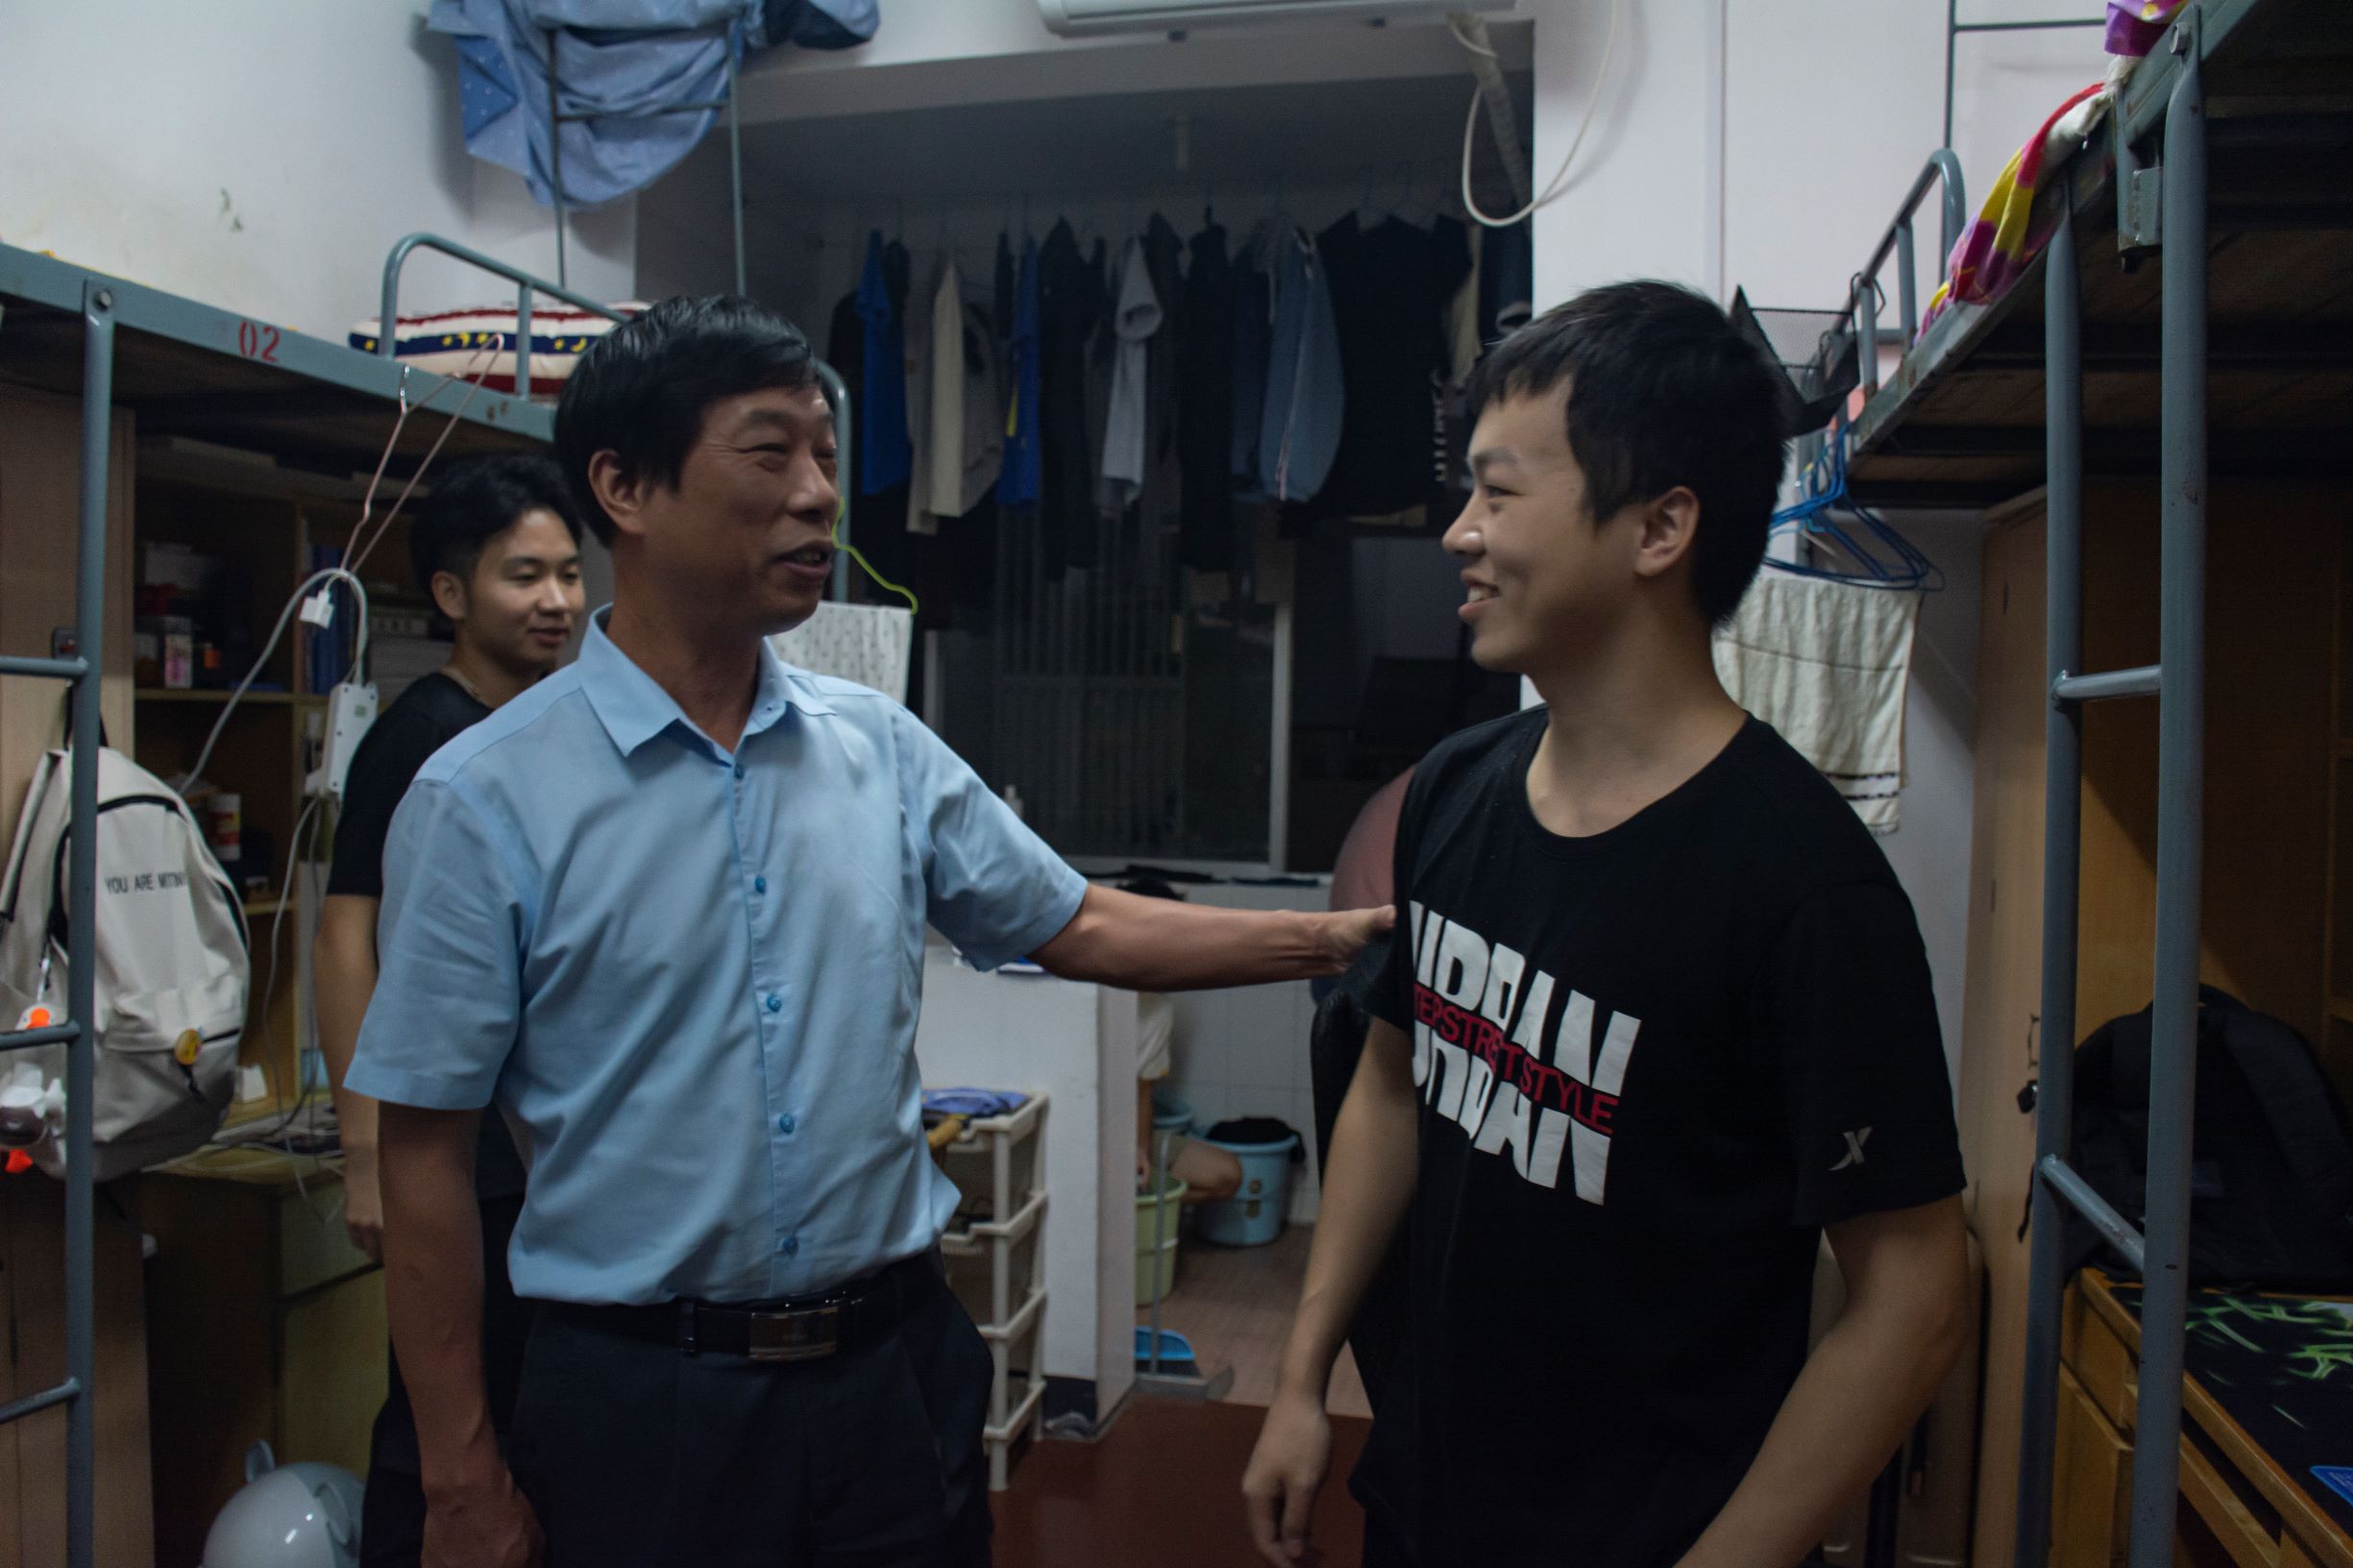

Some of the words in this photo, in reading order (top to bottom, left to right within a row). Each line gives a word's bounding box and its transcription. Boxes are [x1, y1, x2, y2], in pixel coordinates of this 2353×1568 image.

[239, 321, 279, 362] 02
[105, 876, 129, 894] YOU
[135, 873, 155, 892] ARE
